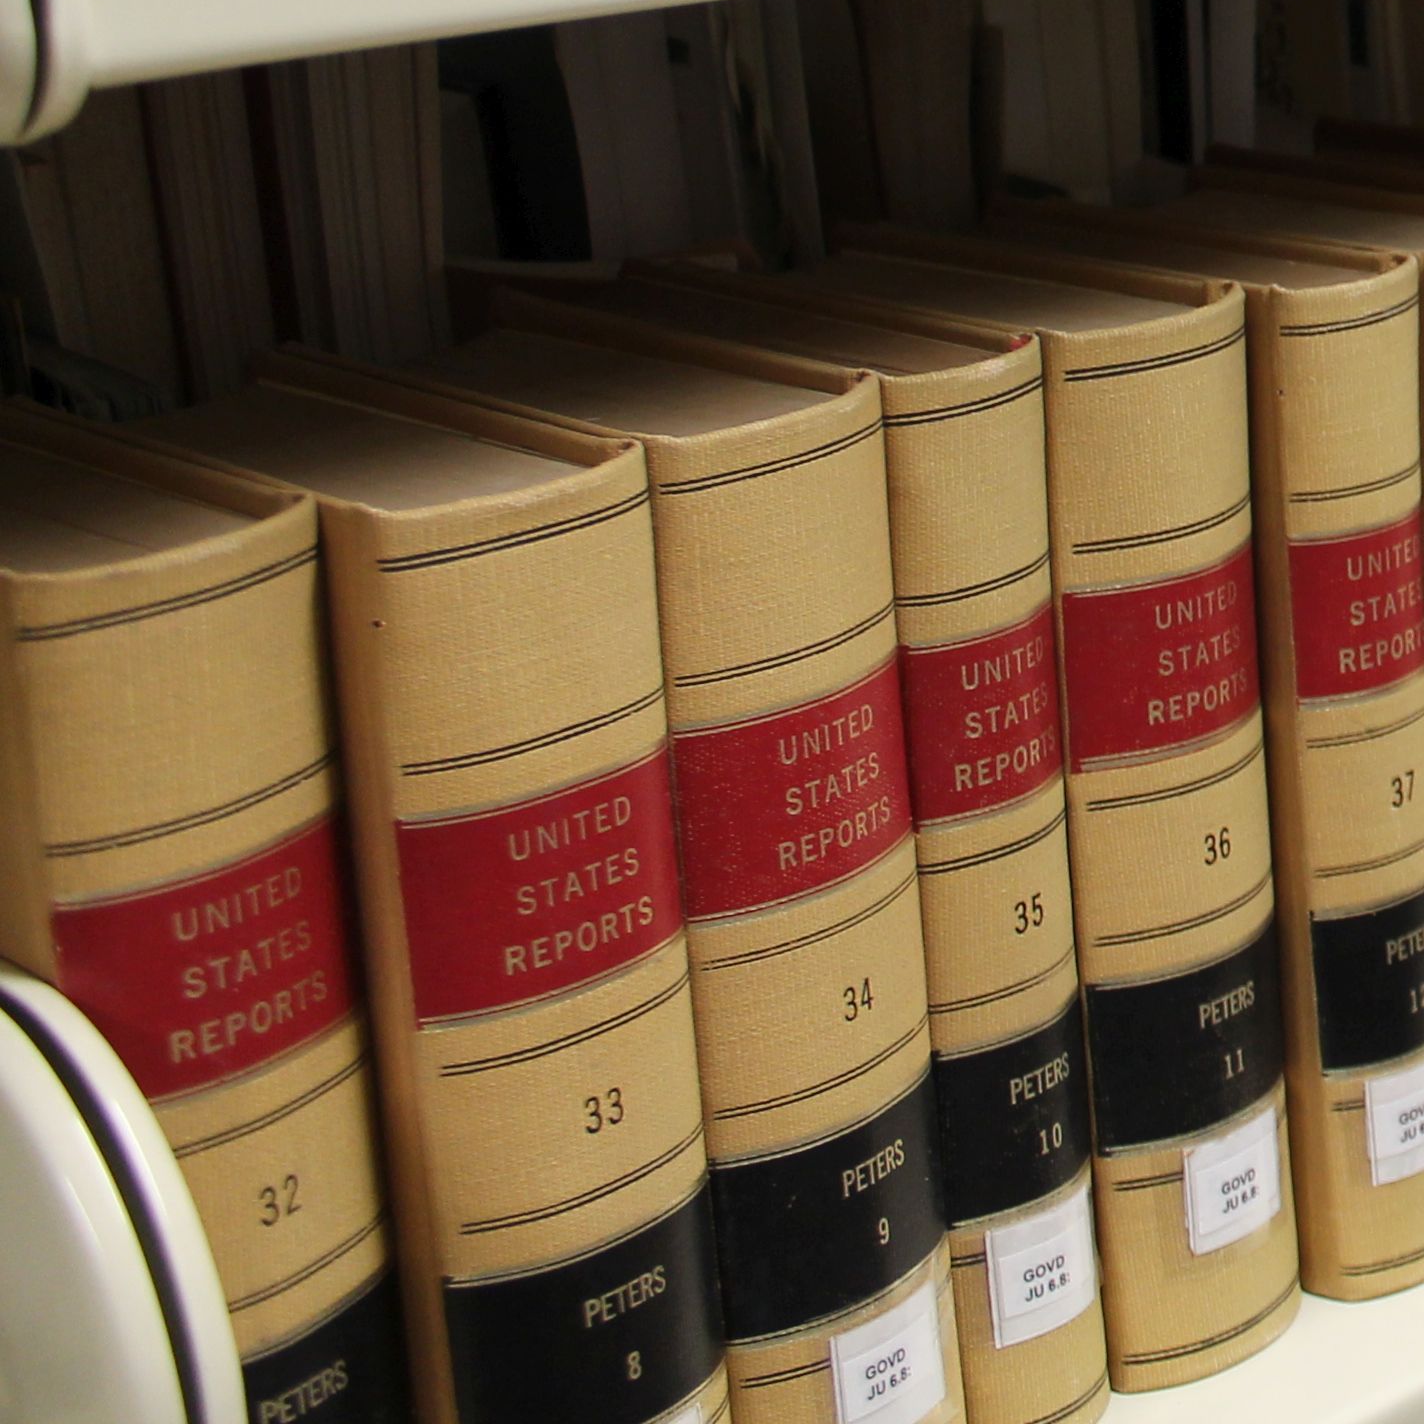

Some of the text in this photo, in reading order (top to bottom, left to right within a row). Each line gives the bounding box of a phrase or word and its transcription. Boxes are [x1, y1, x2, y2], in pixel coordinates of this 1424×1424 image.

[1154, 581, 1238, 631] UNITED
[960, 636, 1044, 692] UNITED
[1157, 628, 1242, 677] STATES
[964, 684, 1049, 741] STATES
[1147, 667, 1248, 727] REPORTS
[777, 704, 875, 766] UNITED
[785, 753, 881, 817] STATES
[954, 728, 1056, 793] REPORTS
[1391, 770, 1415, 810] 37
[507, 795, 633, 861] UNITED
[777, 799, 891, 872] REPORTS
[1203, 826, 1232, 867] 36
[171, 865, 302, 941] UNITED
[515, 847, 640, 916] STATES
[504, 895, 654, 976] REPORTS
[1014, 893, 1044, 935] 35
[182, 922, 312, 998] STATES
[168, 971, 328, 1062] REPORTS
[844, 976, 875, 1023] 34
[1199, 980, 1255, 1030] PETERS
[1010, 1051, 1070, 1107] PETERS
[1223, 1047, 1244, 1078] 11
[584, 1087, 625, 1135] 33
[1400, 1122, 1418, 1143] JU
[1039, 1126, 1063, 1156] 10
[842, 1138, 905, 1199] PETERS
[1220, 1168, 1257, 1198] GOVD
[258, 1174, 302, 1228] 32
[1222, 1194, 1240, 1216] JU
[878, 1216, 891, 1246] 9
[1022, 1253, 1067, 1285] GOVD
[1024, 1272, 1071, 1304] JU 6.8:
[583, 1264, 667, 1329] PETERS
[626, 1351, 642, 1380] 8
[864, 1347, 907, 1380] GOVD
[867, 1366, 912, 1402] JU 6.8:
[259, 1359, 349, 1424] PETERS
